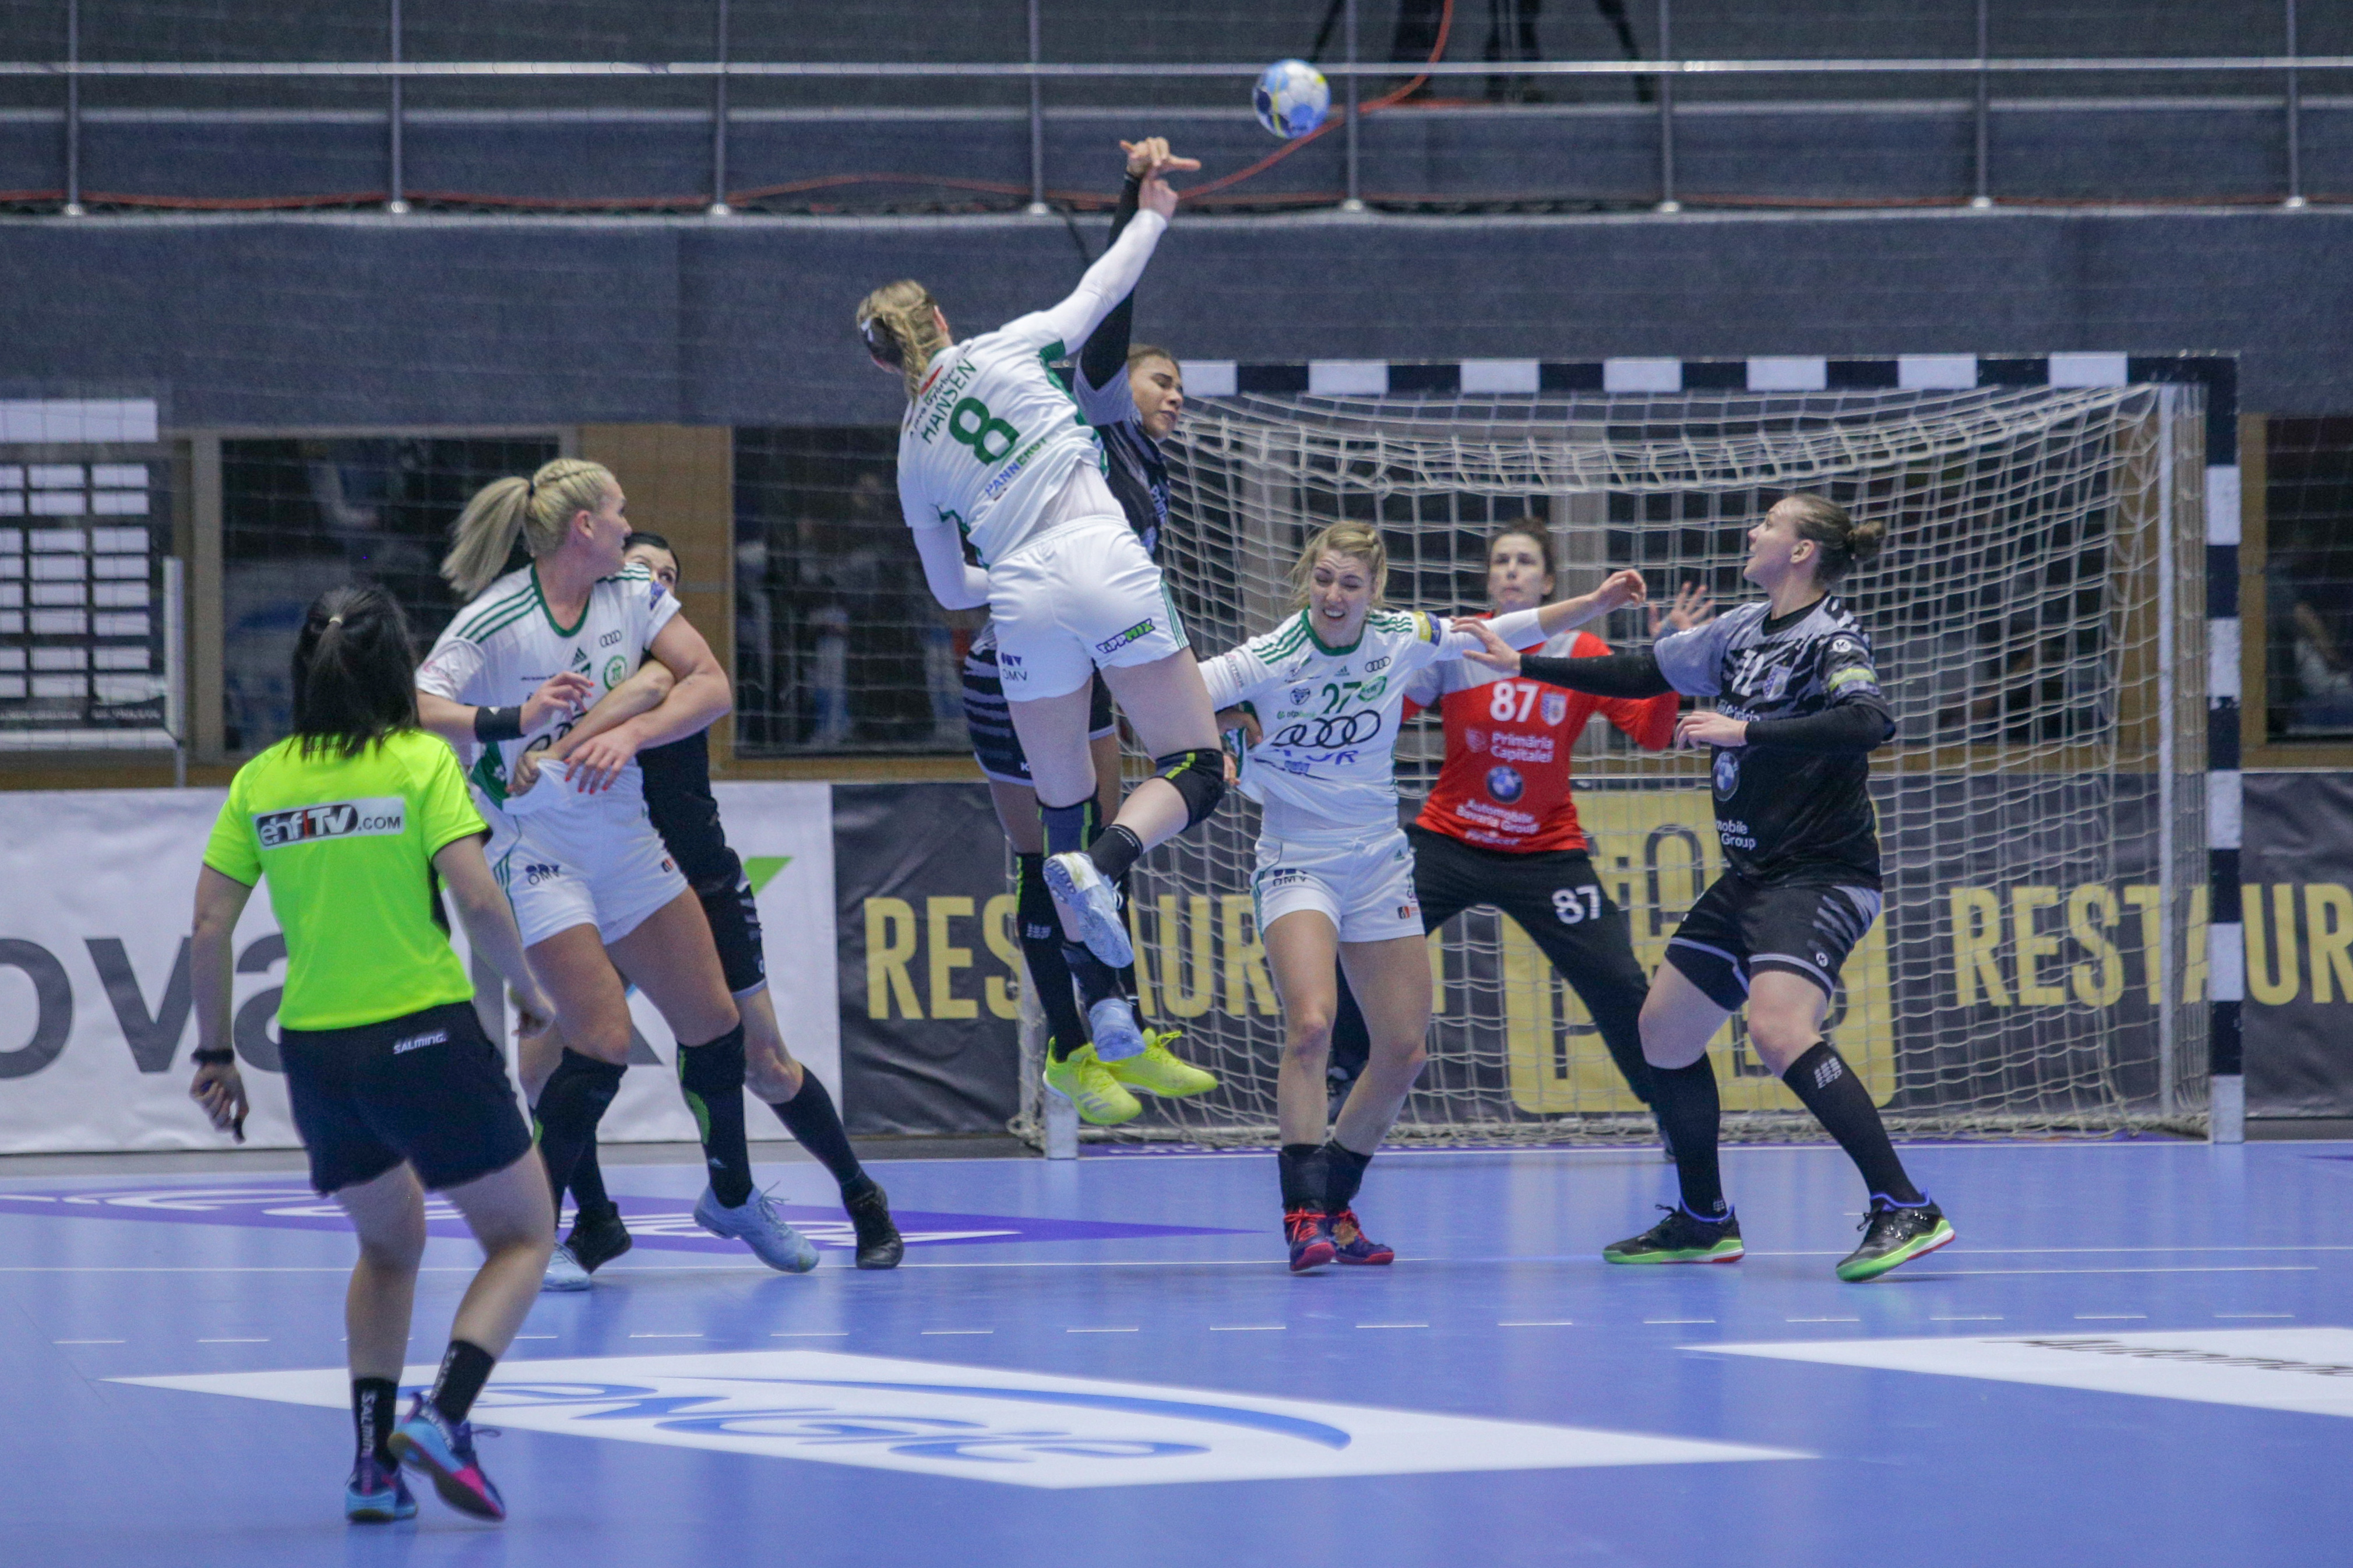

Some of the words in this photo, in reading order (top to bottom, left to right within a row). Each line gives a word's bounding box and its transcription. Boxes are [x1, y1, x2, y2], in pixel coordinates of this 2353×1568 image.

[920, 358, 977, 445] HANSEN
[949, 397, 1020, 466] 8
[1321, 682, 1362, 714] 27
[1491, 683, 1540, 723] 87
[1721, 832, 1757, 851] Group
[1552, 884, 1602, 925] 87
